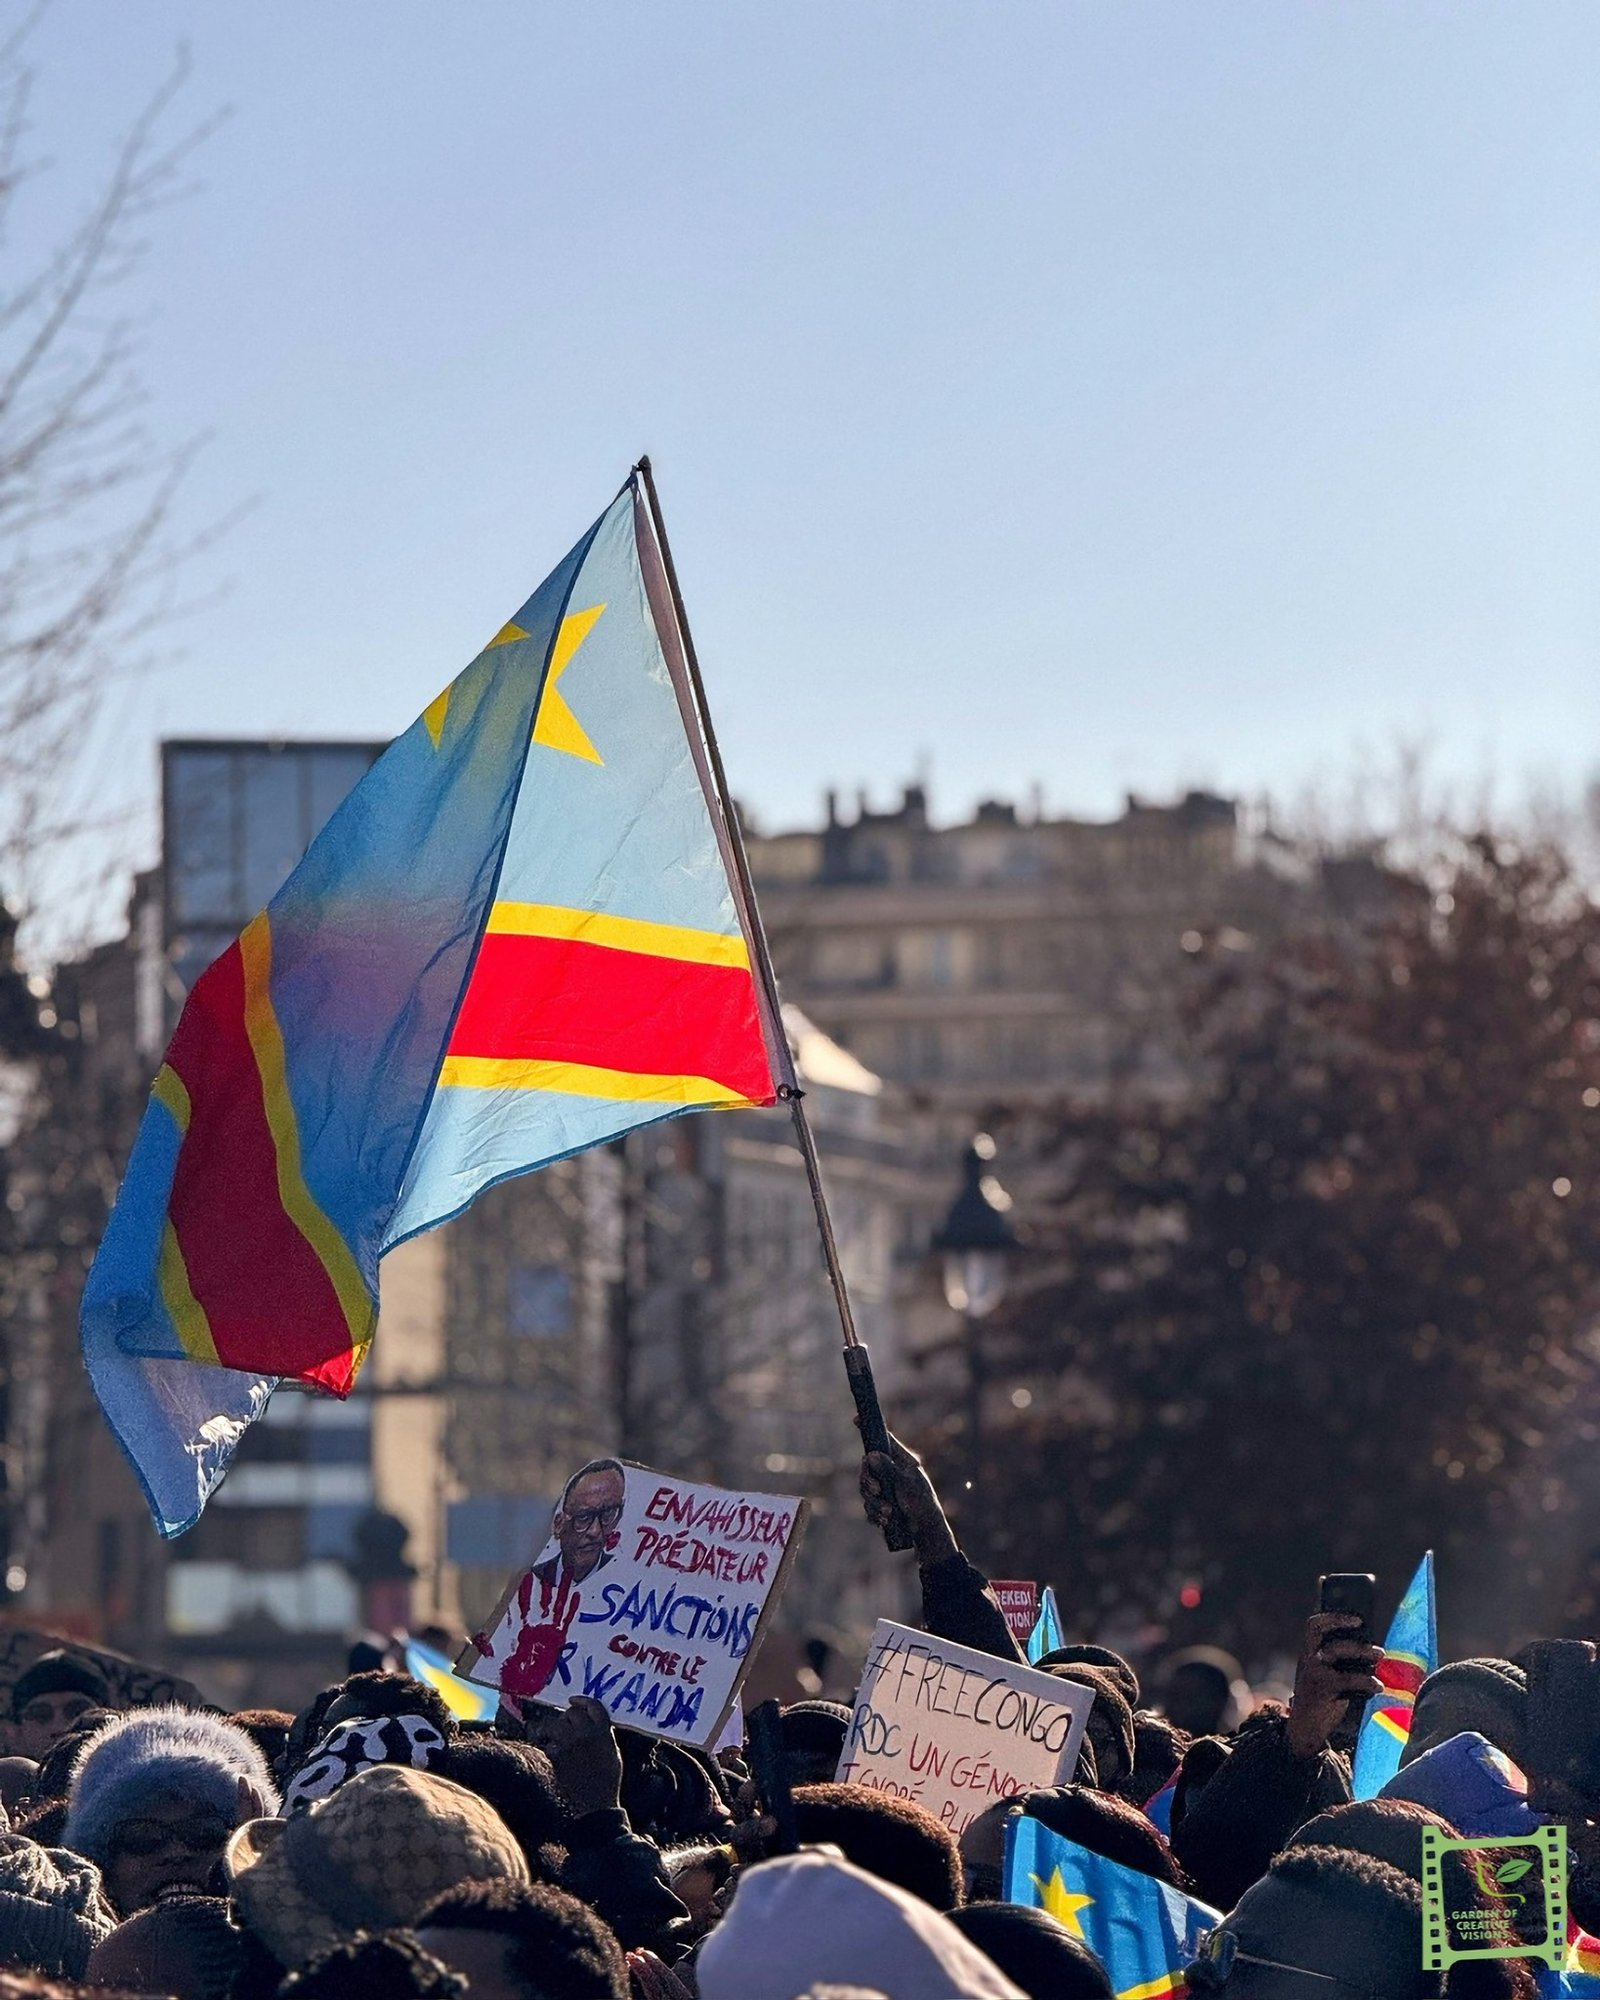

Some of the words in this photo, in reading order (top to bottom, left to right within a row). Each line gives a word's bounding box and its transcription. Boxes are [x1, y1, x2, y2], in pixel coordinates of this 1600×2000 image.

[633, 1525, 769, 1585] PRÉDATEUR
[1005, 1611, 1035, 1628] TION!
[608, 1633, 678, 1676] CONTRE
[680, 1655, 708, 1685] LE
[865, 1631, 1073, 1753] #FREECONGO
[850, 1703, 902, 1758] RDC
[909, 1733, 950, 1778] UN
